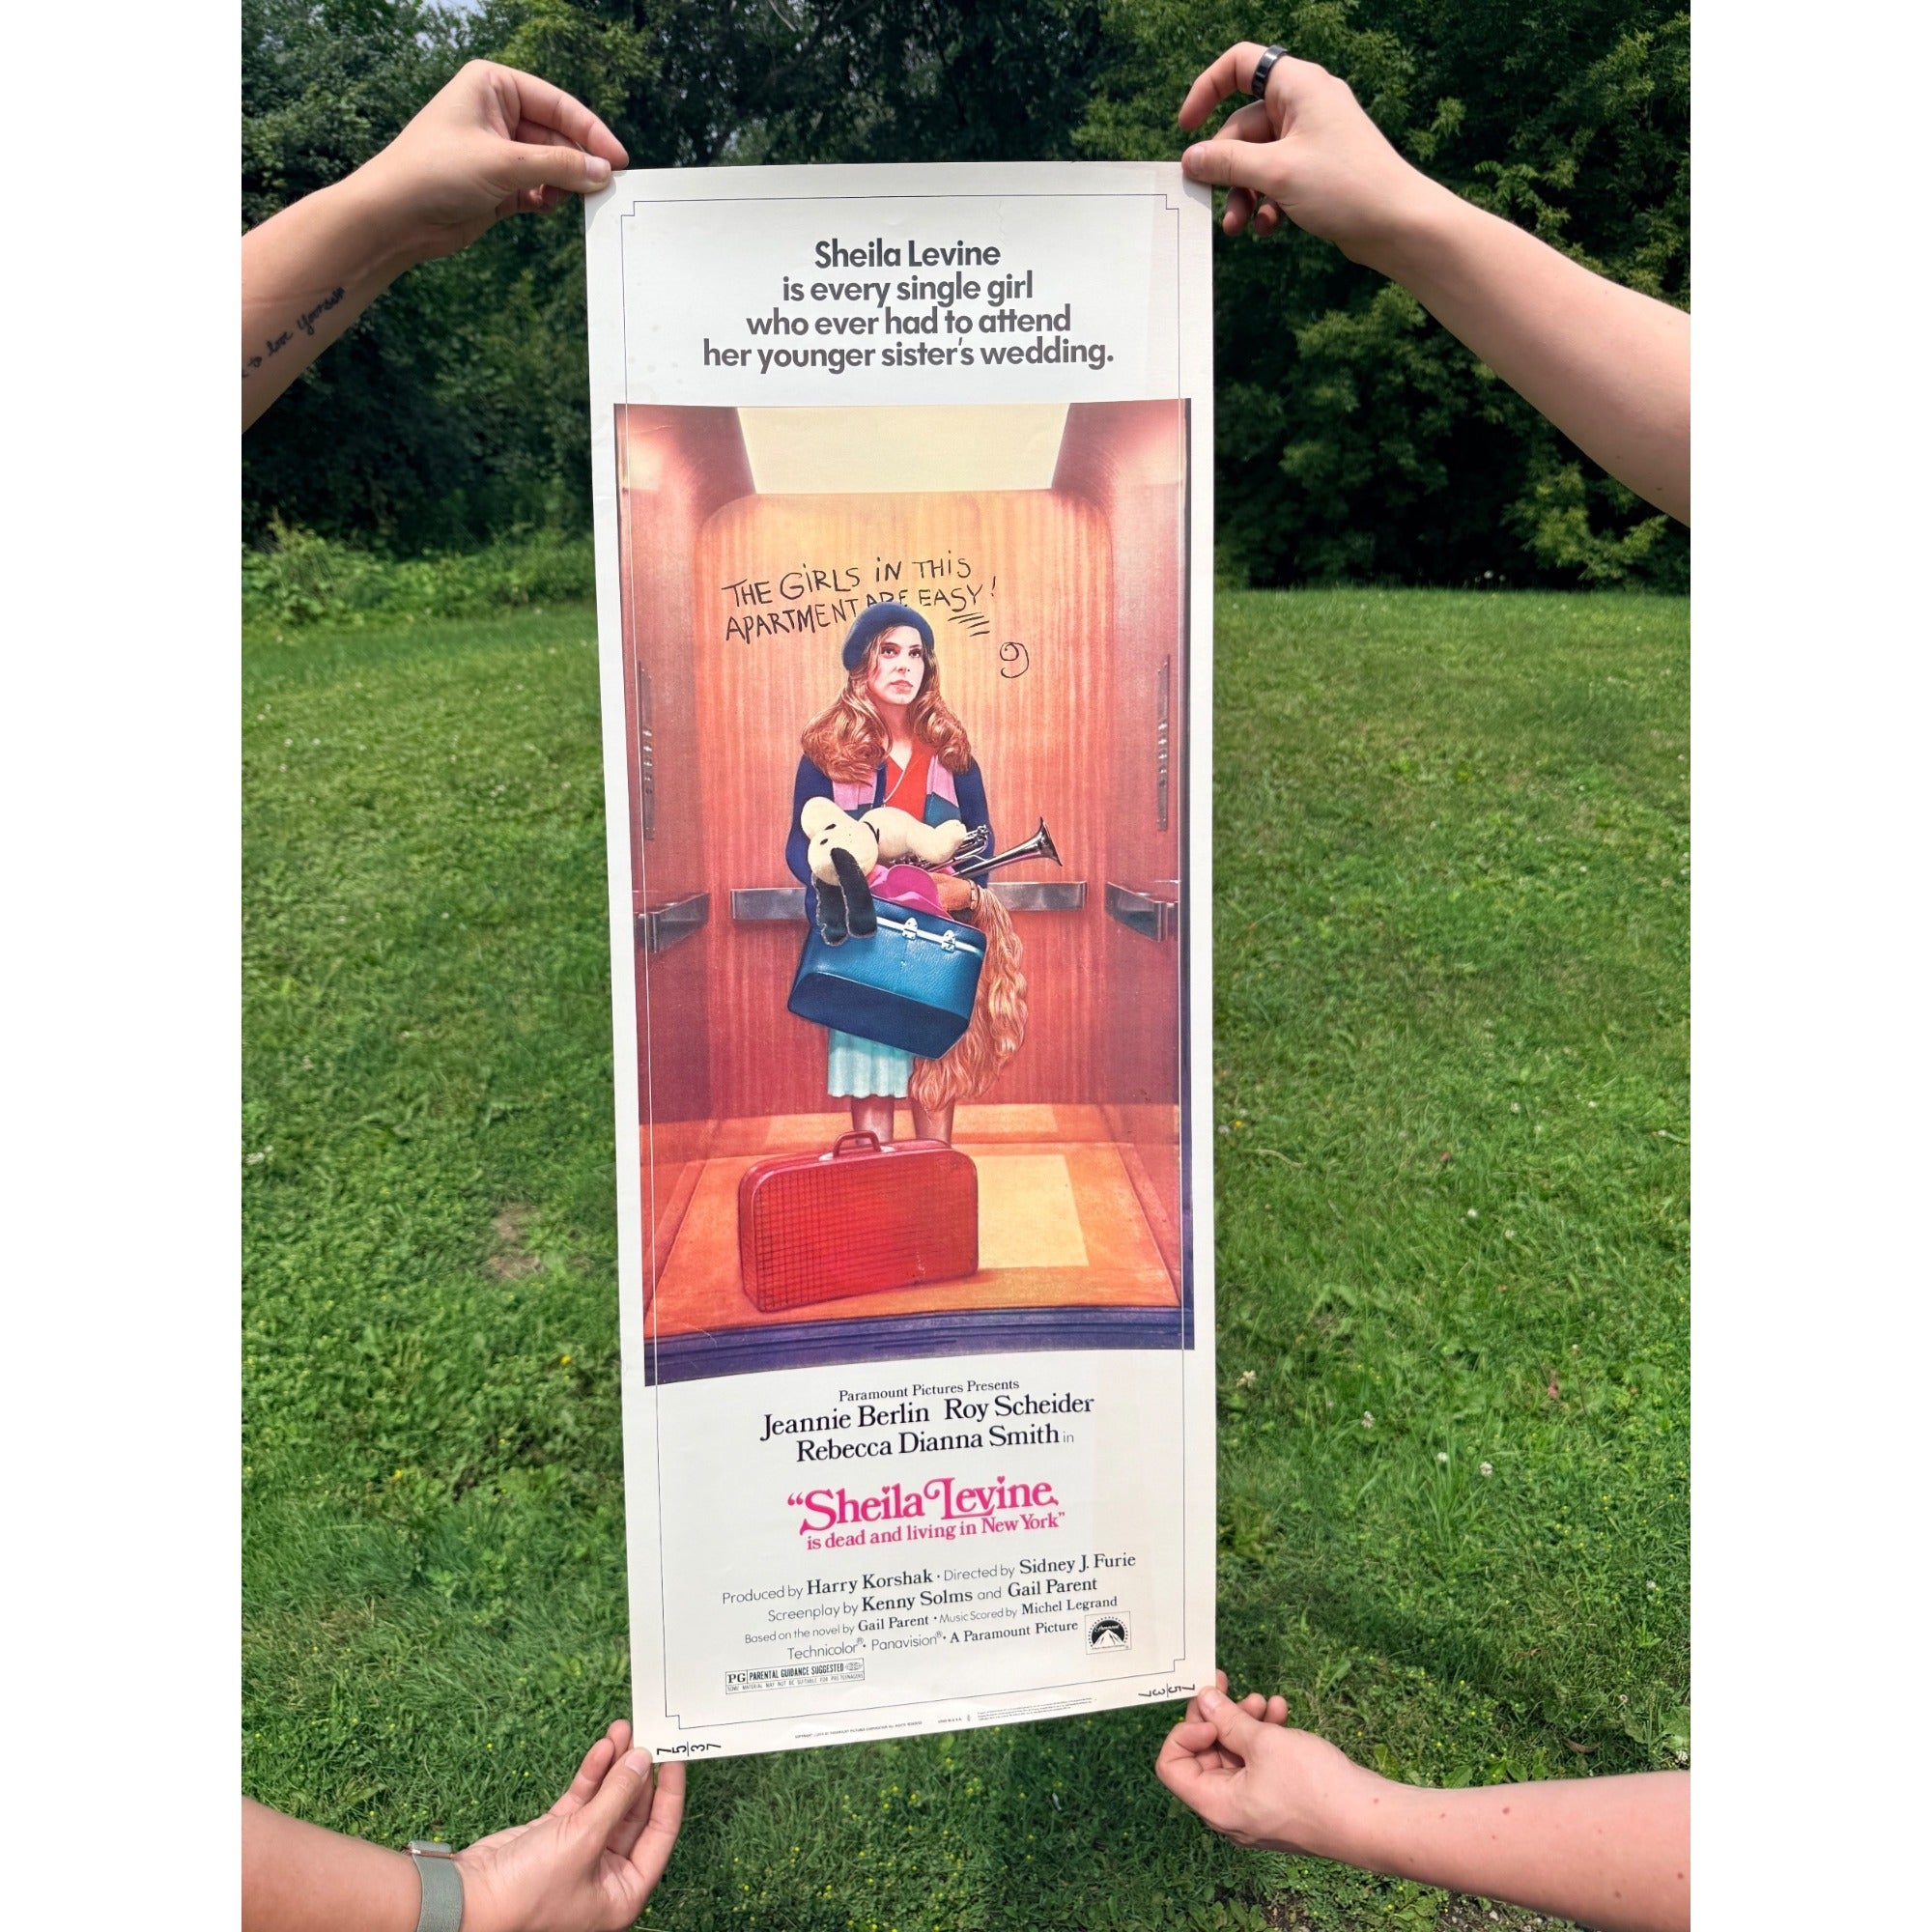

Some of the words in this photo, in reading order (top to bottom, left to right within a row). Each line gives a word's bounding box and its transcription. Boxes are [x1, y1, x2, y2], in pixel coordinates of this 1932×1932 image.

[814, 238, 901, 269] Sheila
[908, 240, 1001, 267] Levine
[782, 275, 805, 301] is
[810, 277, 891, 308] every
[896, 270, 981, 308] single
[987, 270, 1033, 307] girl
[746, 307, 810, 336] who
[814, 313, 879, 335] ever
[885, 305, 938, 334] had
[944, 310, 973, 334] to
[979, 303, 1070, 333] attend
[703, 338, 752, 366] her
[756, 345, 876, 375] younger
[881, 336, 975, 367] sister's
[980, 335, 1114, 370] wedding.
[722, 579, 773, 608] THE
[725, 598, 858, 644] APARTMENT
[838, 1387, 908, 1402] Paramount
[913, 1384, 964, 1396] Pictures
[967, 1380, 1020, 1392] Presents
[759, 1407, 851, 1441] Jeannie
[858, 1402, 930, 1428] Berlin
[944, 1398, 989, 1423] Roy
[994, 1392, 1094, 1416] Scheider
[796, 1438, 893, 1463] Rebecca
[898, 1431, 983, 1454] Dianna
[989, 1423, 1060, 1447] Smith
[1063, 1431, 1074, 1443] in
[807, 1536, 822, 1550] is
[825, 1529, 866, 1548] dead
[869, 1525, 902, 1545] and
[906, 1524, 956, 1541] living
[959, 1520, 977, 1536] in
[981, 1517, 1019, 1534] New
[723, 1588, 784, 1605] Produced
[787, 1584, 804, 1600] by
[807, 1578, 858, 1595] Harry
[863, 1569, 933, 1589] Korshak
[944, 1564, 998, 1581] Directed
[1000, 1564, 1015, 1578] by
[1019, 1558, 1075, 1575] Sidney
[1078, 1554, 1090, 1573] J.
[1094, 1552, 1136, 1568] Furie
[768, 1604, 840, 1622] Screenplay
[842, 1602, 859, 1617] by
[862, 1596, 916, 1612] Kenny
[920, 1589, 973, 1605] Solms
[977, 1585, 1002, 1601] and
[1008, 1580, 1041, 1598] Gail
[1046, 1578, 1097, 1594] Parent
[745, 1631, 777, 1644] Based
[778, 1632, 792, 1640] on
[793, 1628, 810, 1638] the
[812, 1624, 840, 1636] novel
[842, 1623, 855, 1635] by
[858, 1618, 885, 1632] Gail
[889, 1615, 928, 1629] Parent
[939, 1611, 969, 1624] Music
[970, 1607, 1004, 1621] Scored
[1006, 1607, 1017, 1619] by
[1022, 1600, 1063, 1615] Michel
[1066, 1596, 1118, 1611] Legrand
[950, 1632, 960, 1643] A
[963, 1626, 1031, 1642] Paramount
[1036, 1622, 1078, 1634] Picture
[727, 1673, 746, 1683] PG
[749, 1670, 779, 1681] PARENTAL
[781, 1667, 810, 1678] GUIDANCE
[811, 1663, 844, 1675] SUGGESTED
